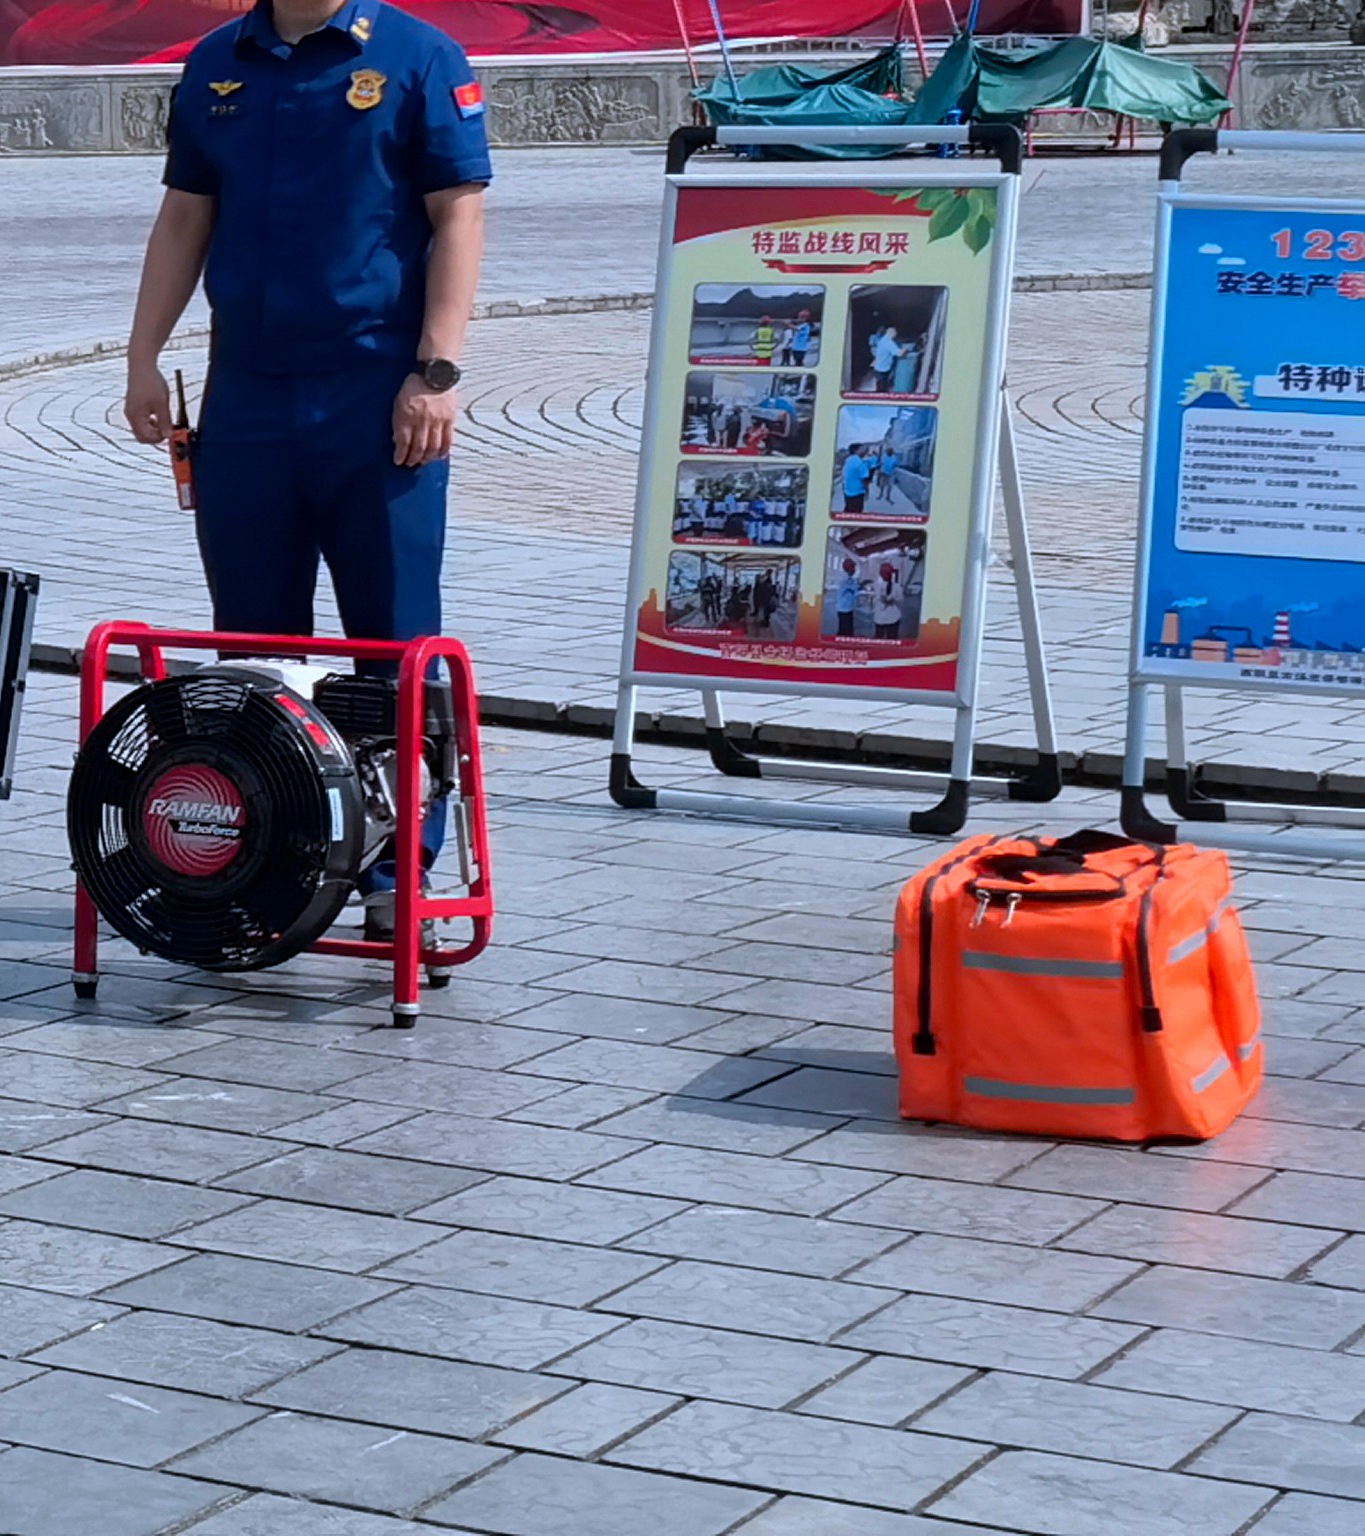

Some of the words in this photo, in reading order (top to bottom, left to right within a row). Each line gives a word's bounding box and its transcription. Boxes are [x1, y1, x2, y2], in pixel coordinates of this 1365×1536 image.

[751, 230, 910, 255] 特监战线风采
[148, 798, 241, 822] RAMFAN
